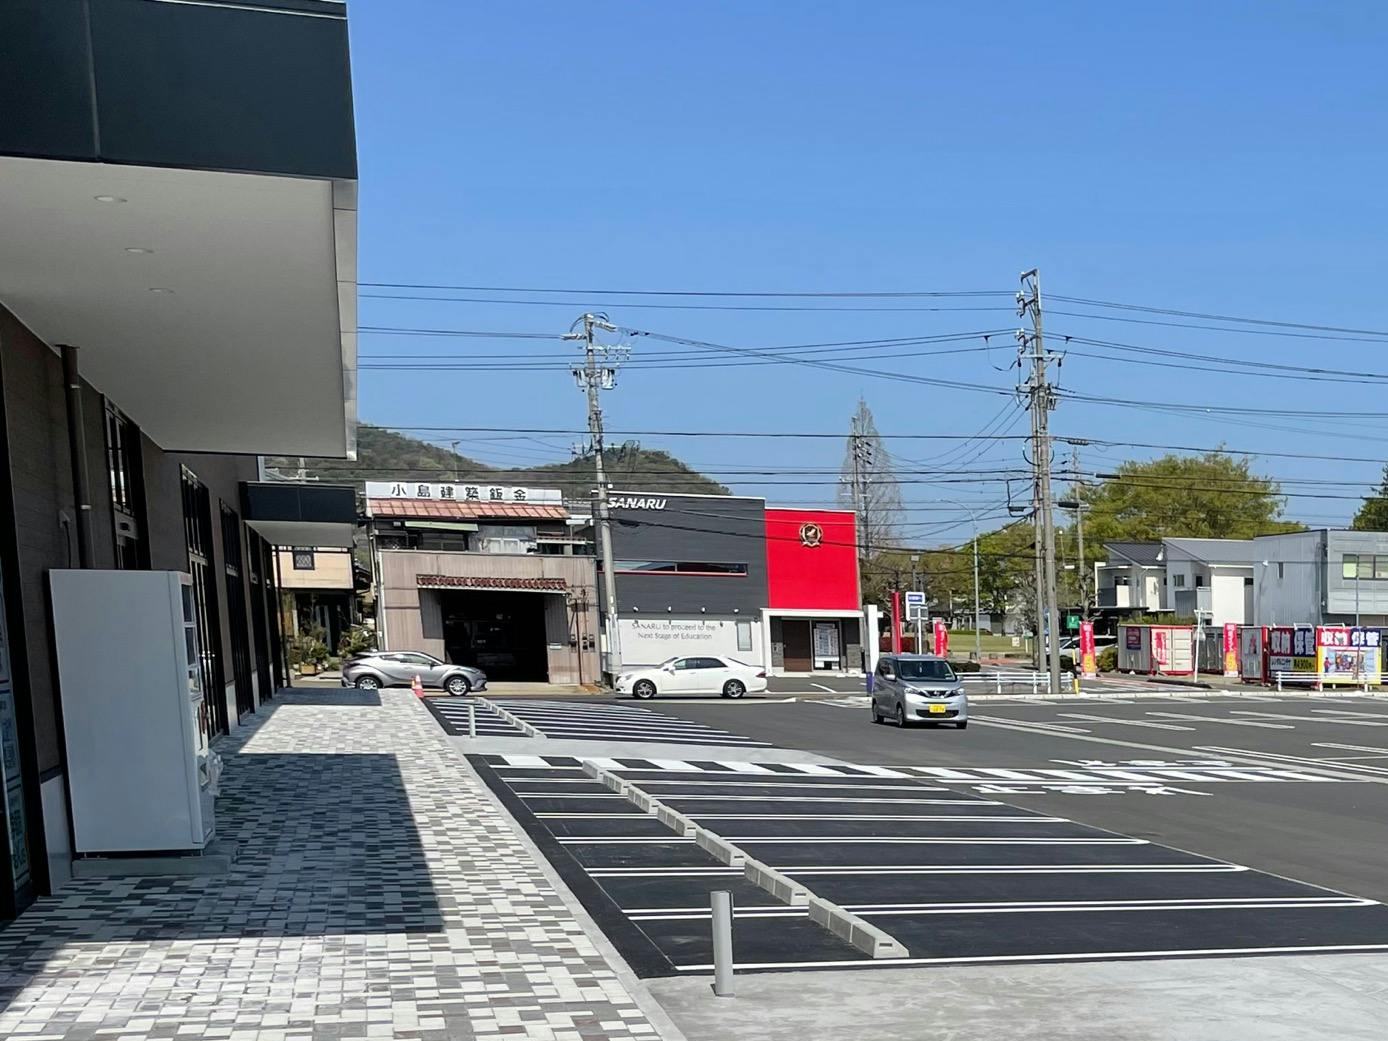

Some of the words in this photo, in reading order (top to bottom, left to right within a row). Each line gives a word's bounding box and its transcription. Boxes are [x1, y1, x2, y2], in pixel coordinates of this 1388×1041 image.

[391, 484, 527, 501] 小島建築鈑金
[607, 497, 667, 510] SANARU
